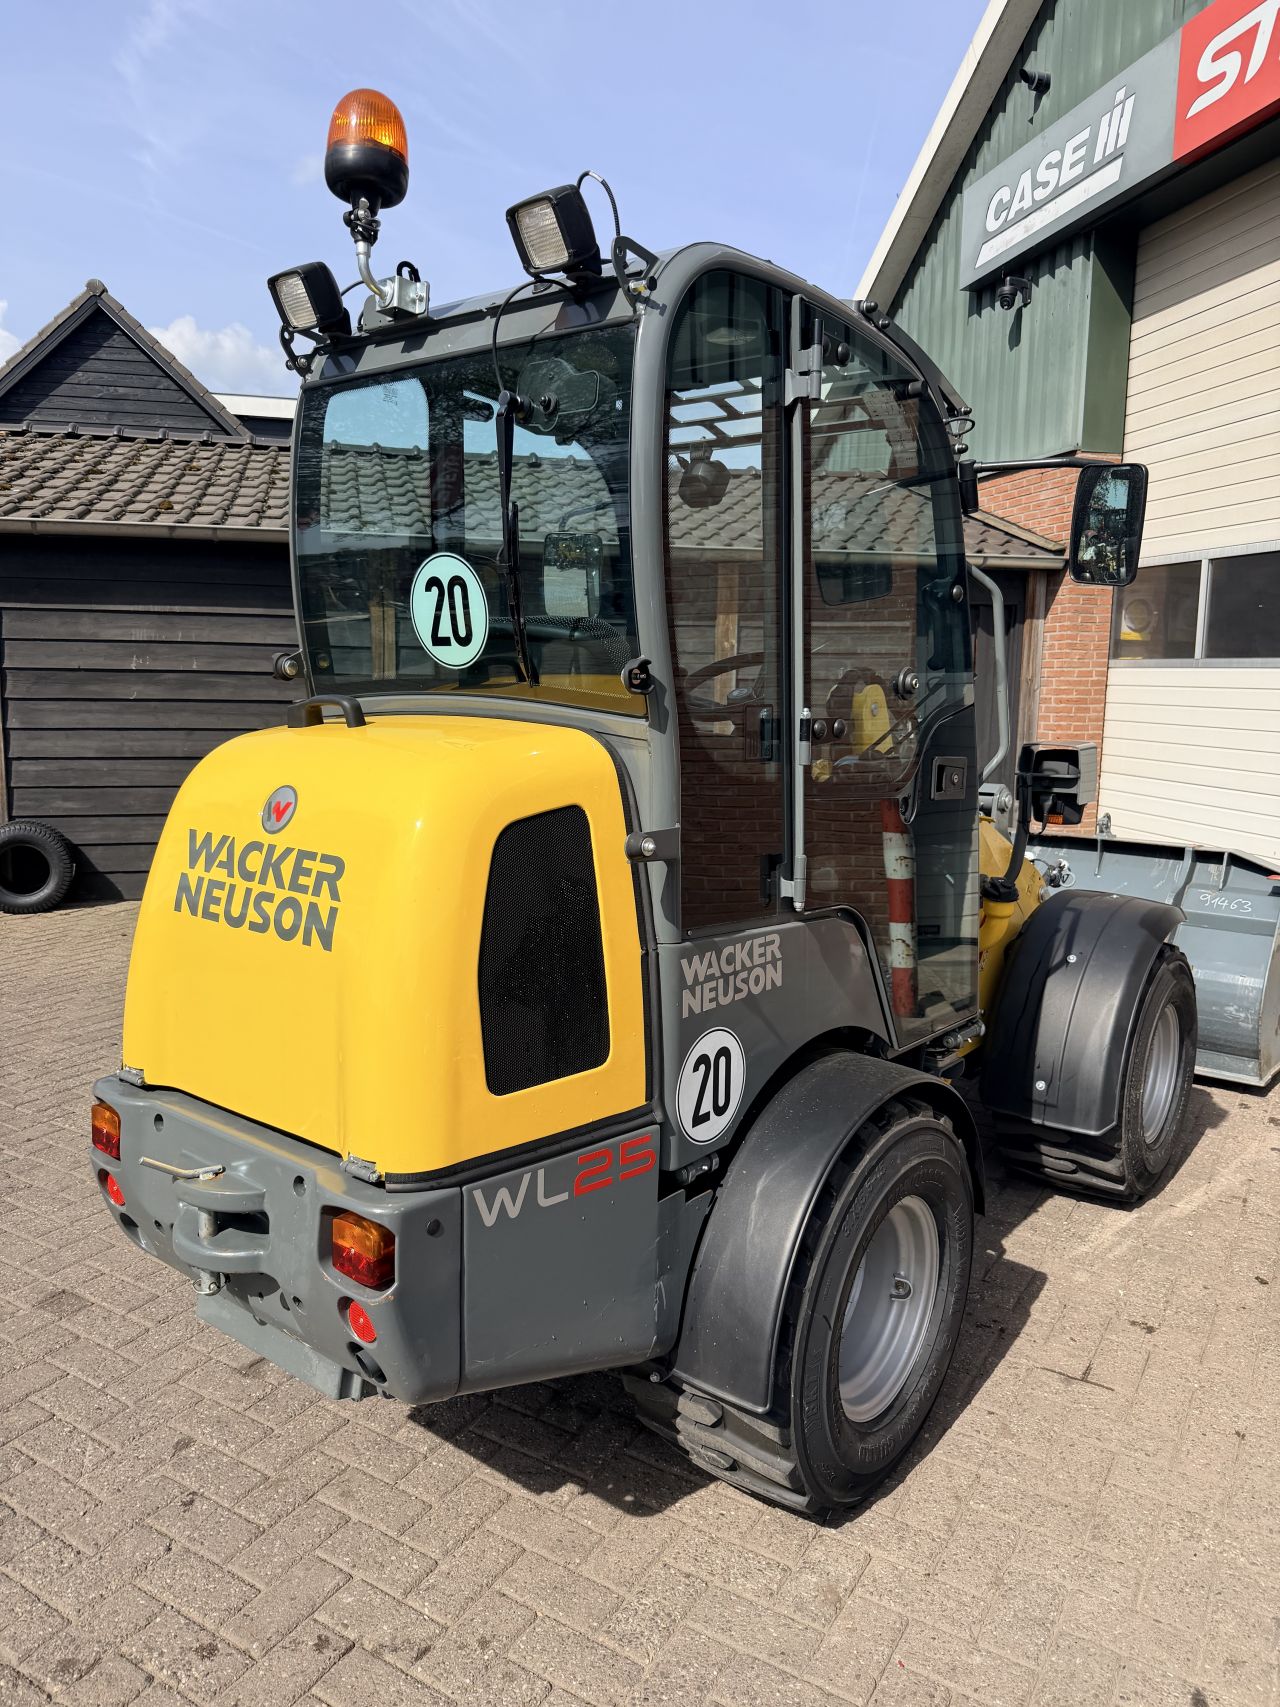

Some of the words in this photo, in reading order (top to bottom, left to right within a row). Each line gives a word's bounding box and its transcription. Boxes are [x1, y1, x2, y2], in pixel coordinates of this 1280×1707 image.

[1185, 0, 1280, 120] ST
[985, 125, 1091, 233] CASE
[424, 575, 473, 647] 20
[188, 828, 346, 902] WACKER
[173, 871, 339, 952] NEUSON
[1199, 893, 1252, 913] 91463
[680, 933, 782, 986] WACKER
[682, 960, 783, 1018] NEUSON
[692, 1046, 732, 1128] 20
